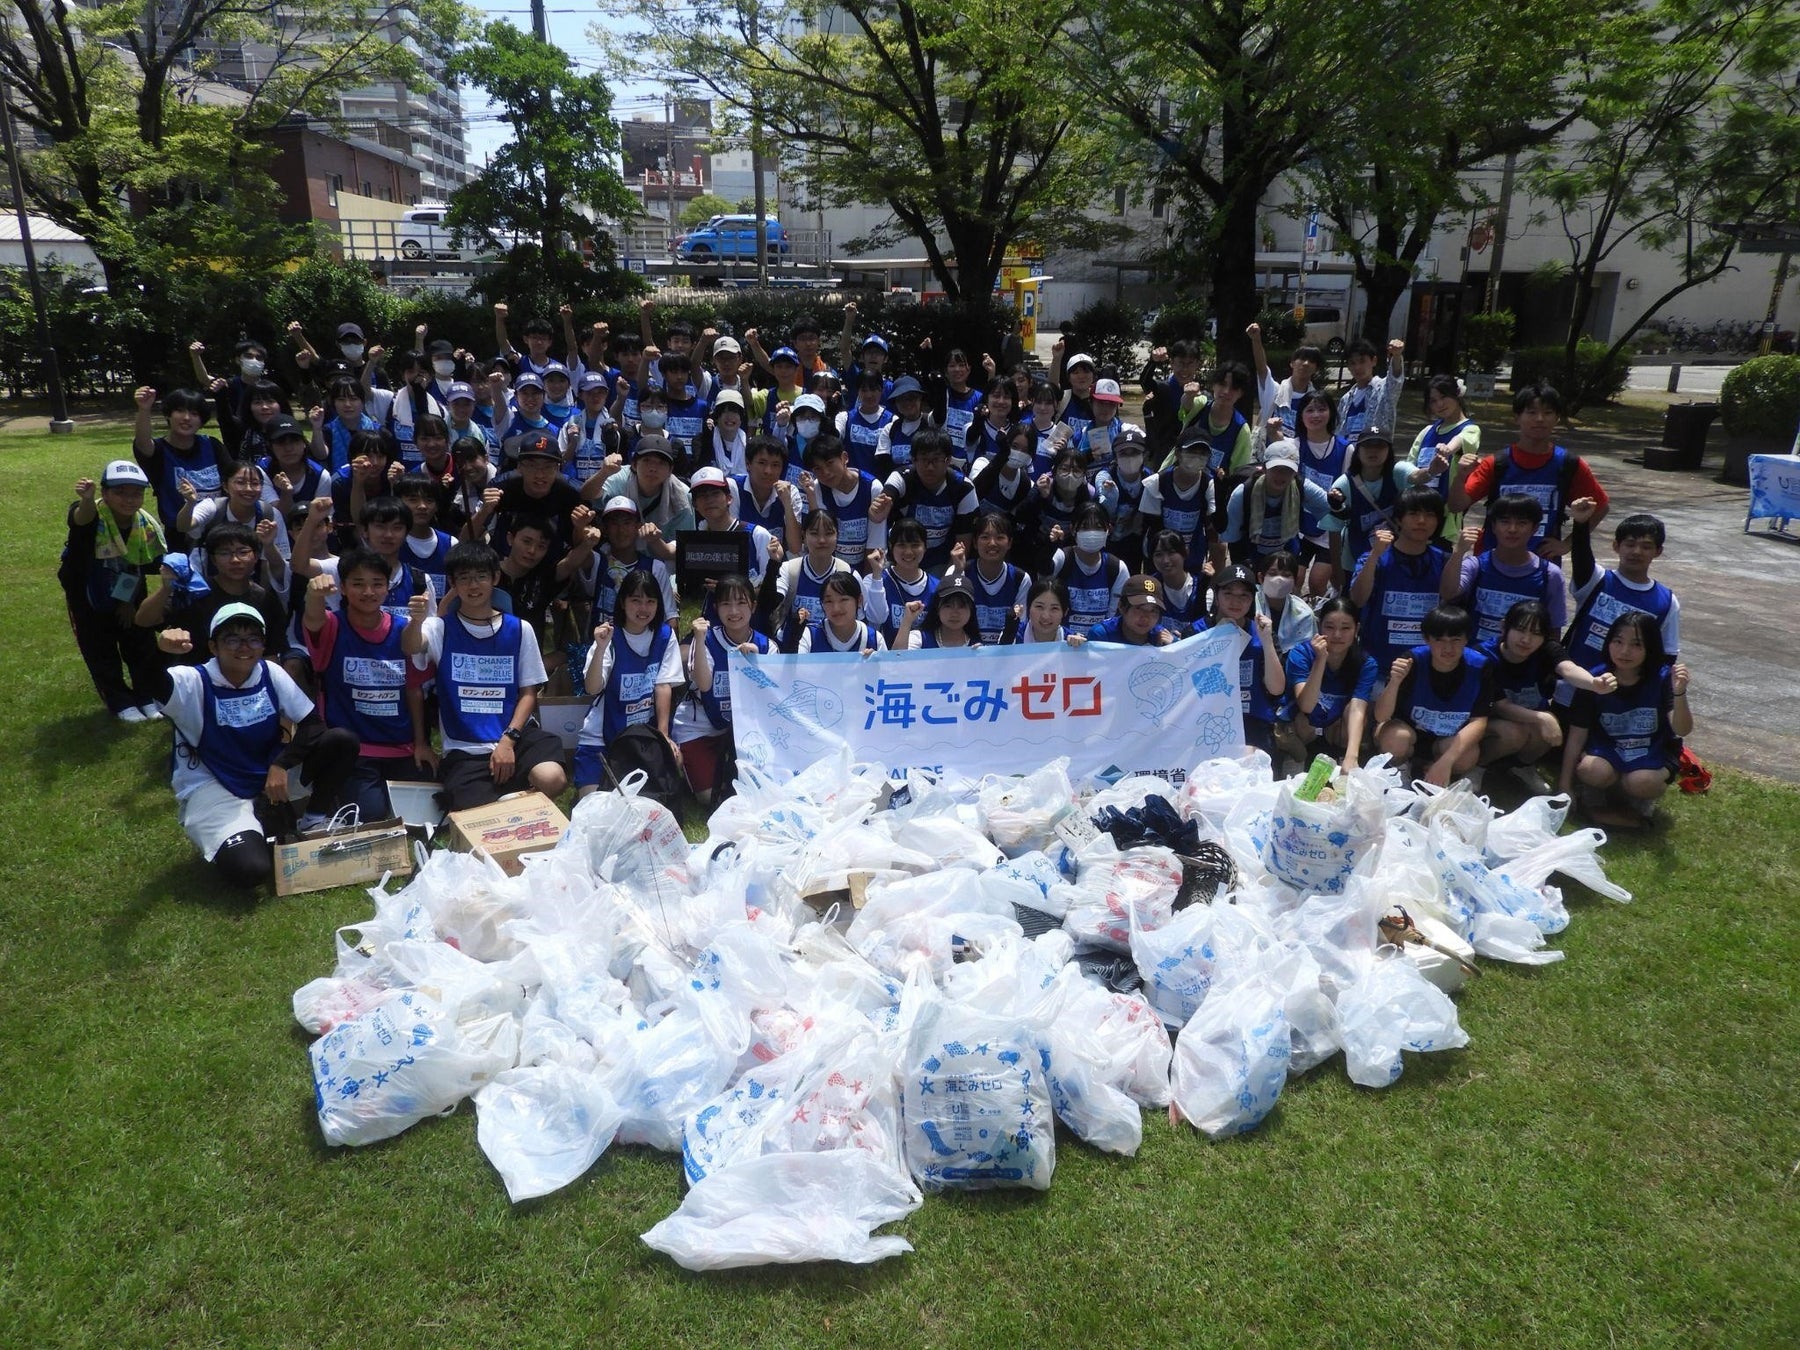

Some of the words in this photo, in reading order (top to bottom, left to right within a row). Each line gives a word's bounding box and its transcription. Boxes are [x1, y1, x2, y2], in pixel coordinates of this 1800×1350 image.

[1024, 292, 1034, 315] P
[1235, 567, 1245, 578] LA
[1144, 580, 1155, 592] SD
[865, 674, 1101, 729] 海ごみゼロ
[945, 1080, 1002, 1092] 海ごみゼロ
